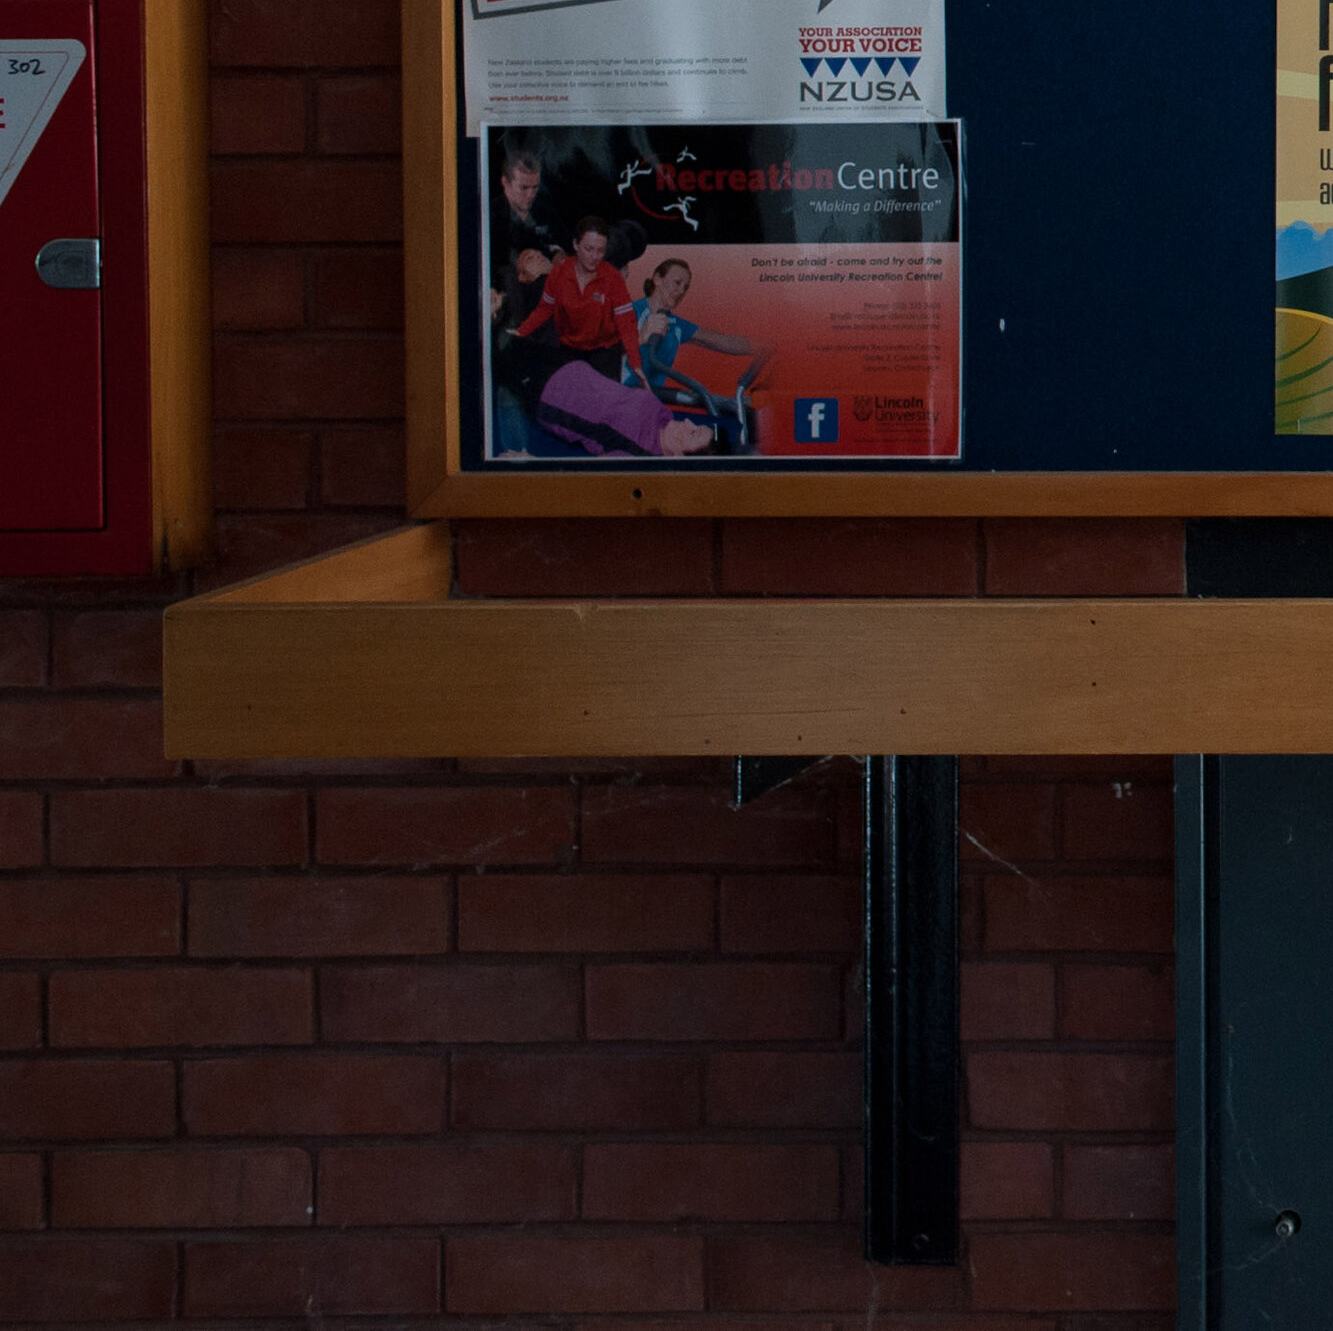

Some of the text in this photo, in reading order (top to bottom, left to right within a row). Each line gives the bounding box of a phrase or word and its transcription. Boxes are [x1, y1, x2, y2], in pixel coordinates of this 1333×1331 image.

[799, 27, 921, 37] YOUR ASSOCIATION
[799, 38, 921, 52] YOUR VOICE
[8, 59, 45, 75] 302
[800, 81, 920, 101] NZUSA
[838, 162, 940, 190] Centre
